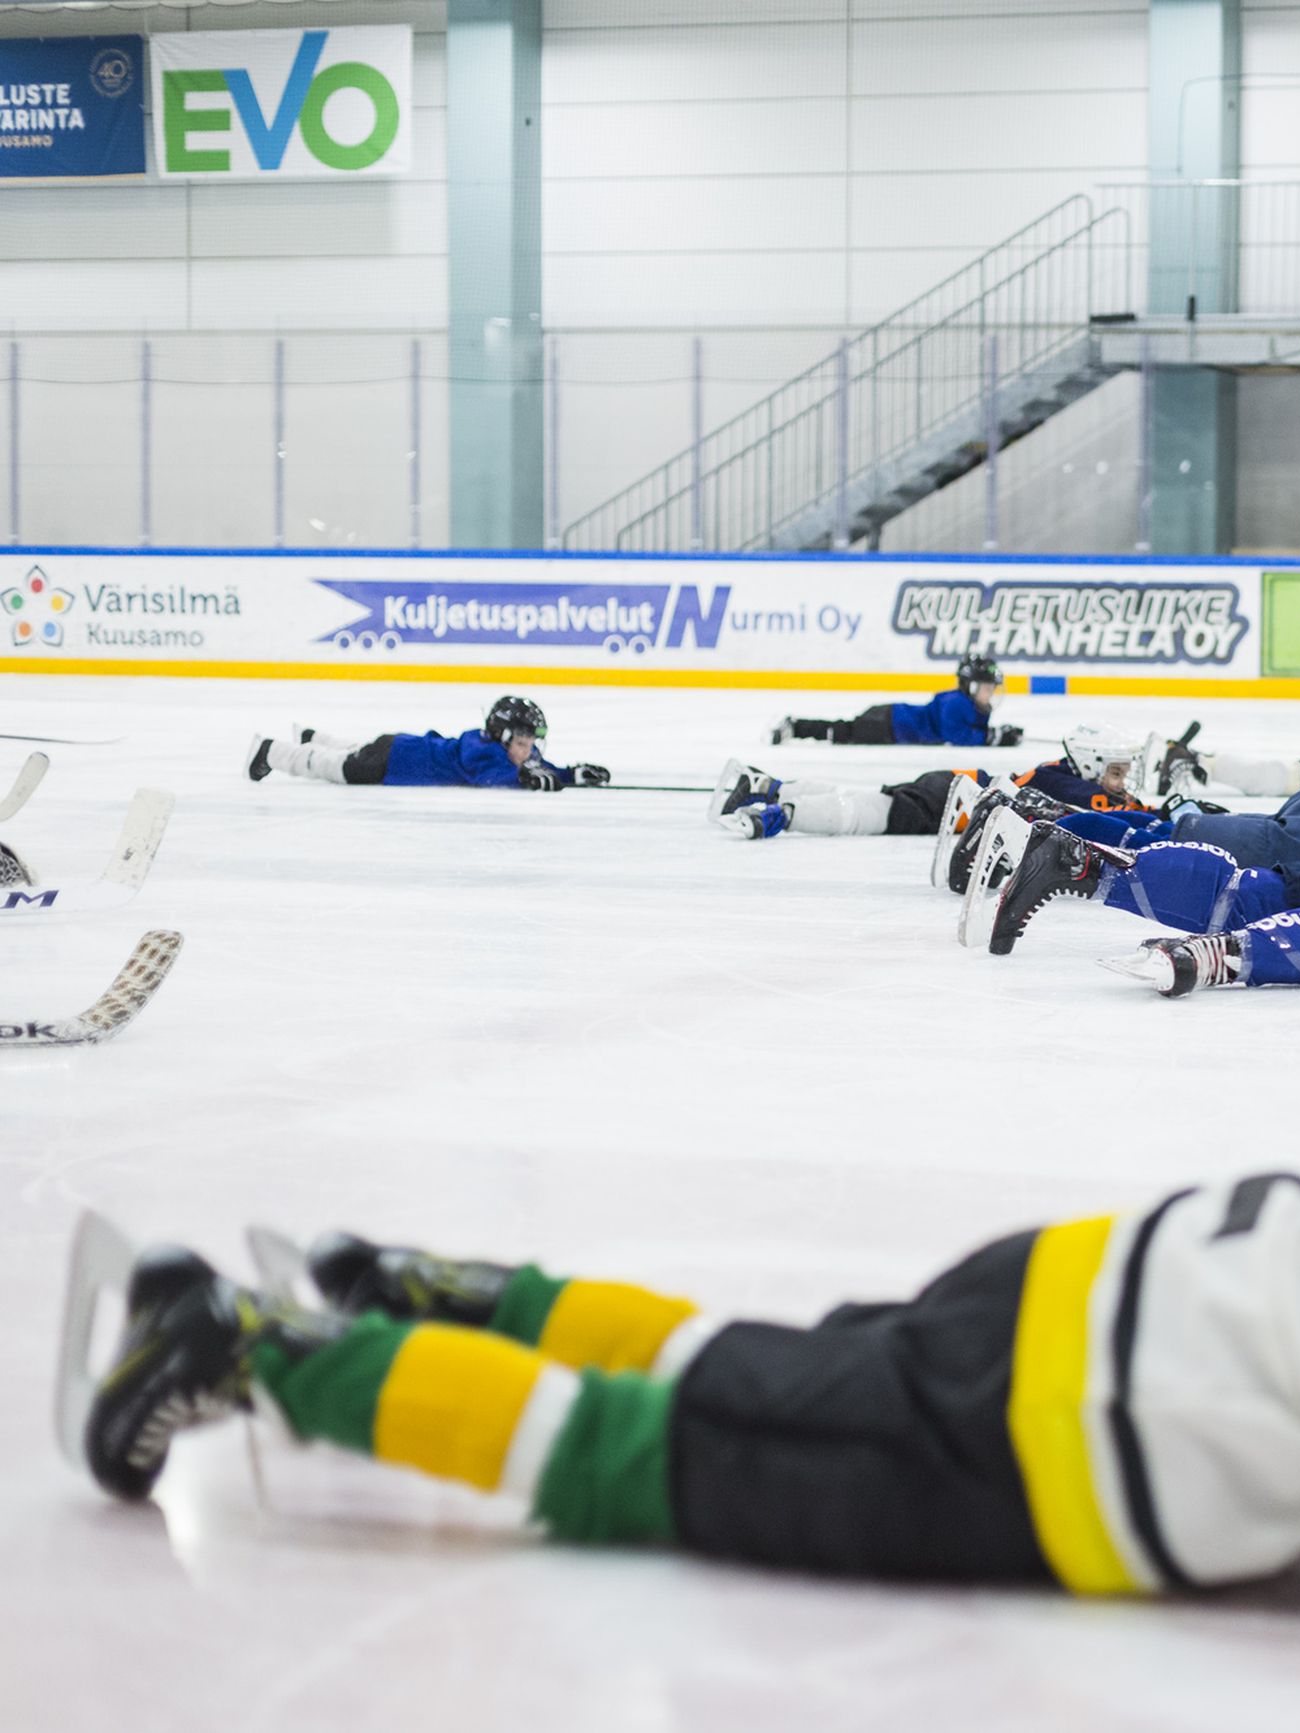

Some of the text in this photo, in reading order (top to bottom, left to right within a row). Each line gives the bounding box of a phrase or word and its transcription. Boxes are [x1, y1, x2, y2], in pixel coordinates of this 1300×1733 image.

[162, 30, 400, 173] EVO
[84, 584, 241, 615] Värisilmä
[384, 594, 655, 639] Kuljetuspalvelut
[818, 605, 862, 640] Oy
[897, 586, 1235, 630] KULJETUSLIIKE
[87, 624, 204, 648] Kuusamo
[1183, 622, 1243, 659] OY
